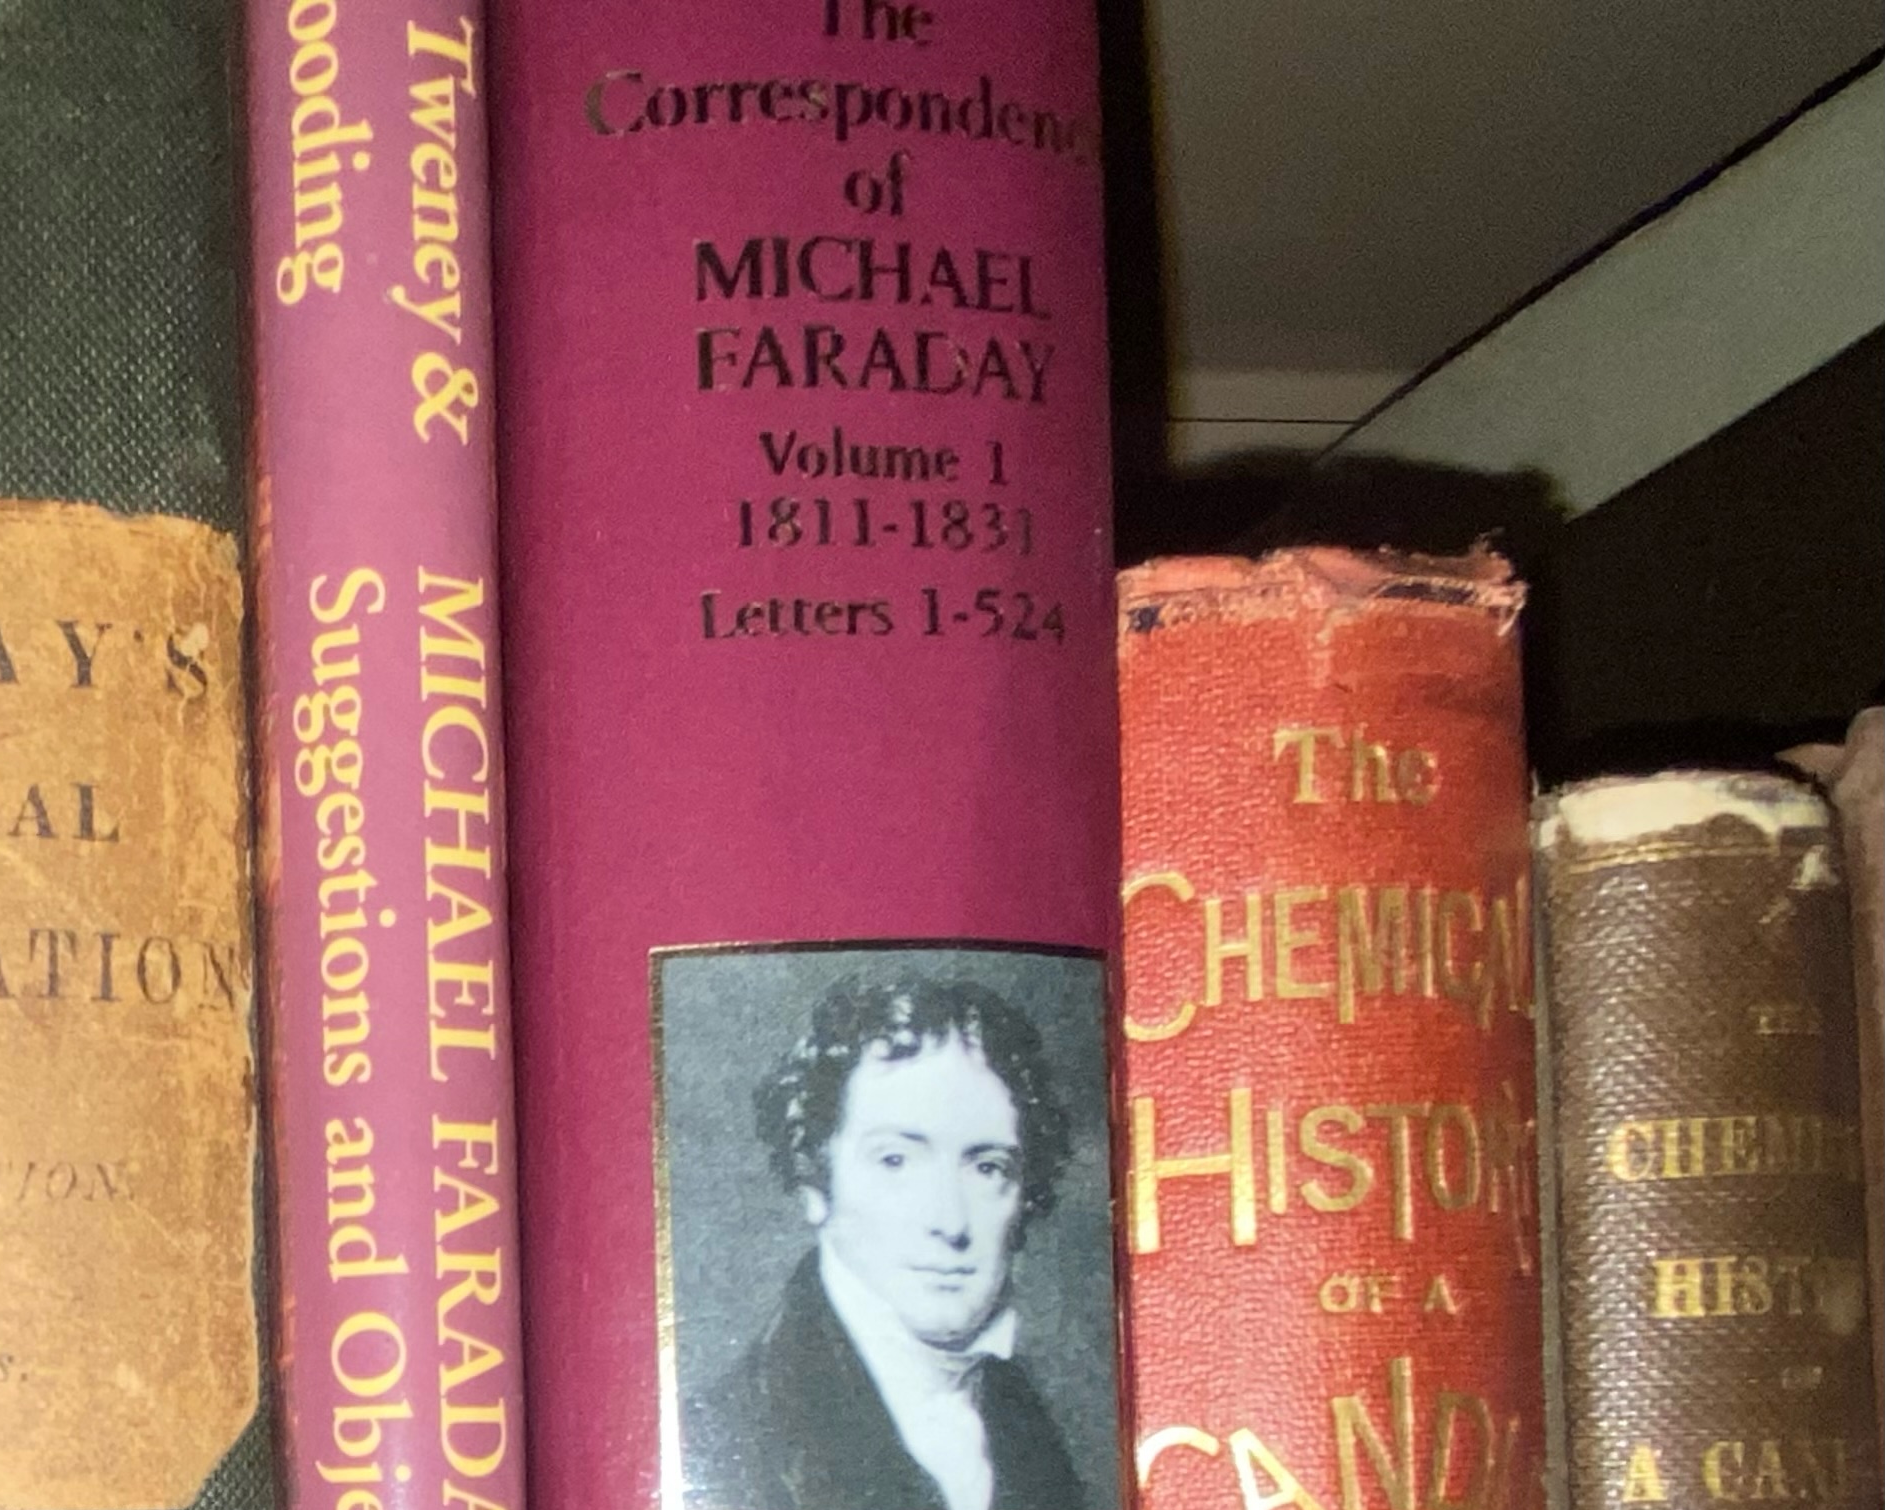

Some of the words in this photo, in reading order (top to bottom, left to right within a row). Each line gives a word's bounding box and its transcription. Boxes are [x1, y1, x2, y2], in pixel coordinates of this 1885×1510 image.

[386, 16, 477, 345] Tweney
[843, 149, 910, 216] of
[693, 236, 1053, 321] MICHAEL
[412, 351, 479, 446] &
[695, 325, 1056, 407] FARADAY
[758, 426, 959, 482] Volume
[988, 441, 1010, 486] 1
[738, 497, 1032, 555] 1811-1831
[700, 589, 894, 640] Letters
[920, 587, 1065, 644] 1-524
[1273, 723, 1442, 804] The
[293, 567, 397, 1087] Suggestions
[418, 565, 498, 1083] MICHAEL
[324, 1116, 410, 1283] and
[1318, 1271, 1396, 1314] OF
[1424, 1274, 1461, 1315] A
[1622, 1443, 1669, 1502] A
